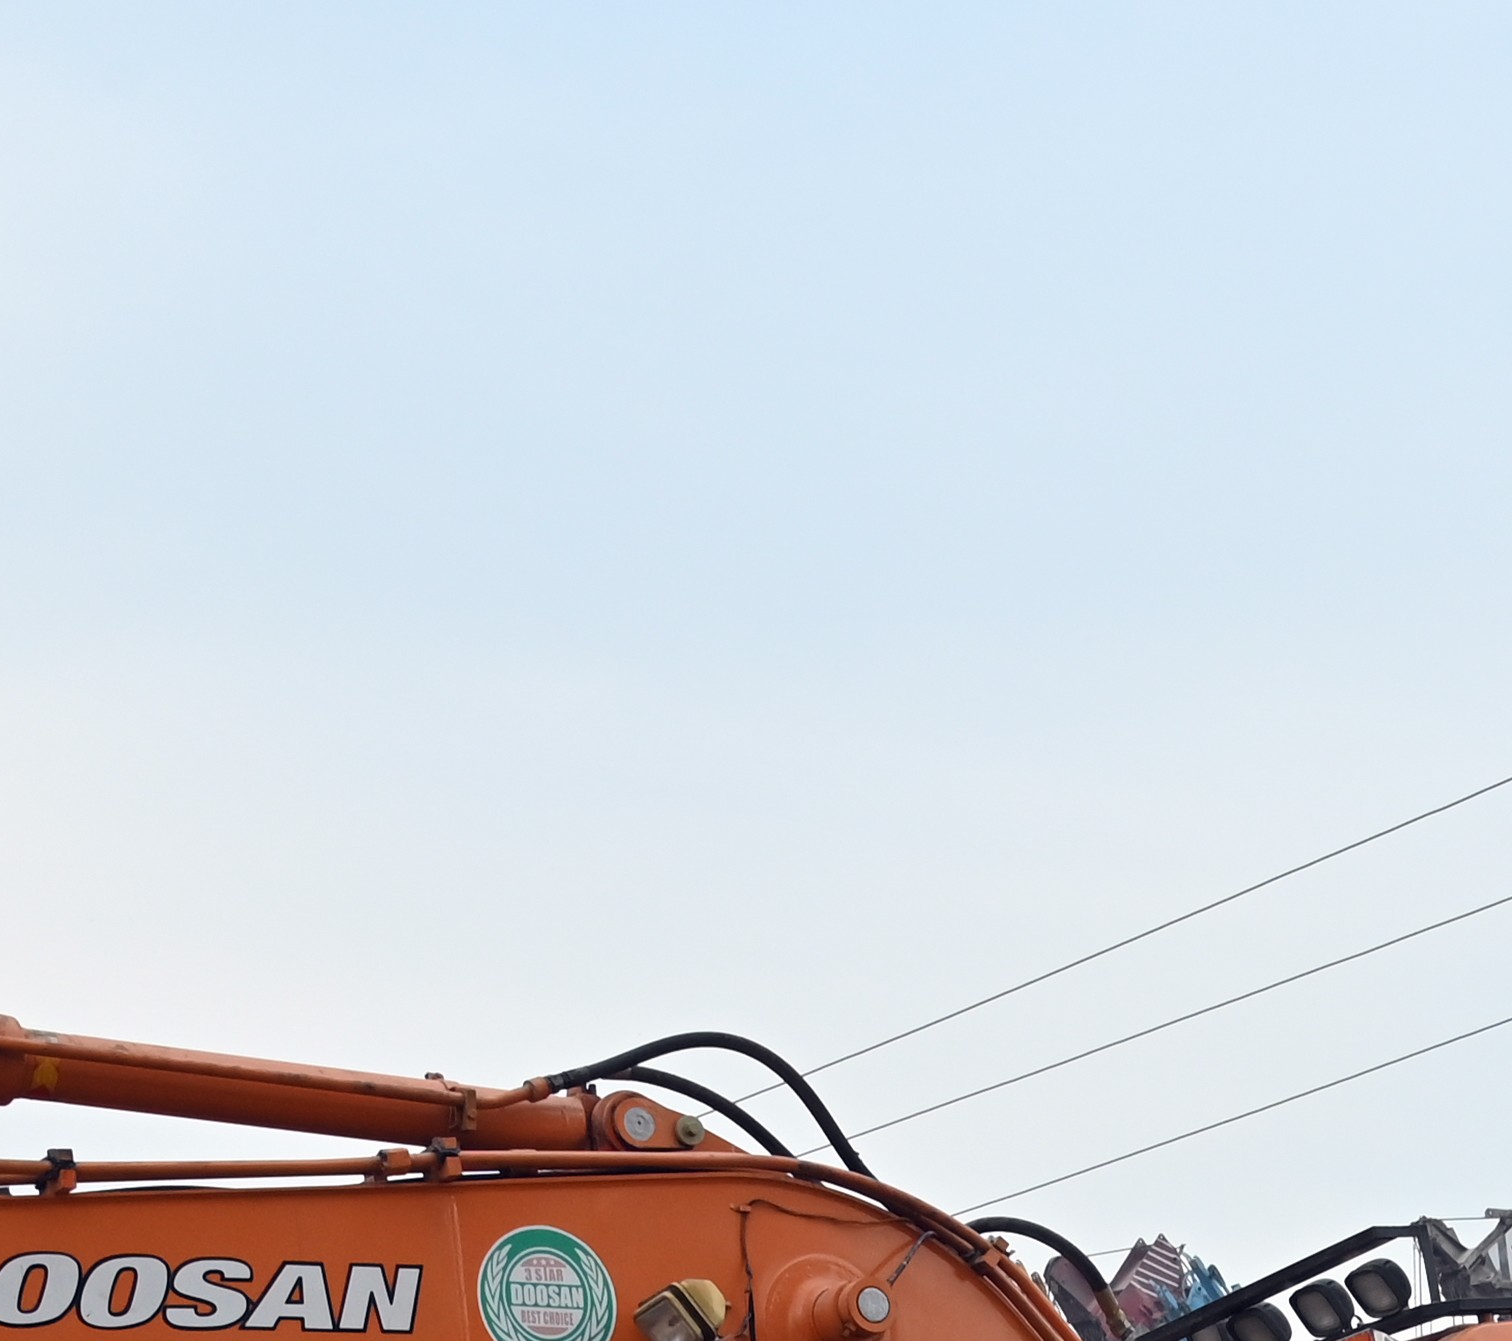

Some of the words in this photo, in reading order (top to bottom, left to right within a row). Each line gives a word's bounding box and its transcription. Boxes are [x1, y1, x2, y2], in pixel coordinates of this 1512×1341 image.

[524, 1268, 532, 1281] 3
[535, 1265, 564, 1282] STAR
[510, 1283, 584, 1308] DOOSAN
[521, 1310, 541, 1325] BEST
[543, 1311, 574, 1326] CHOICE
